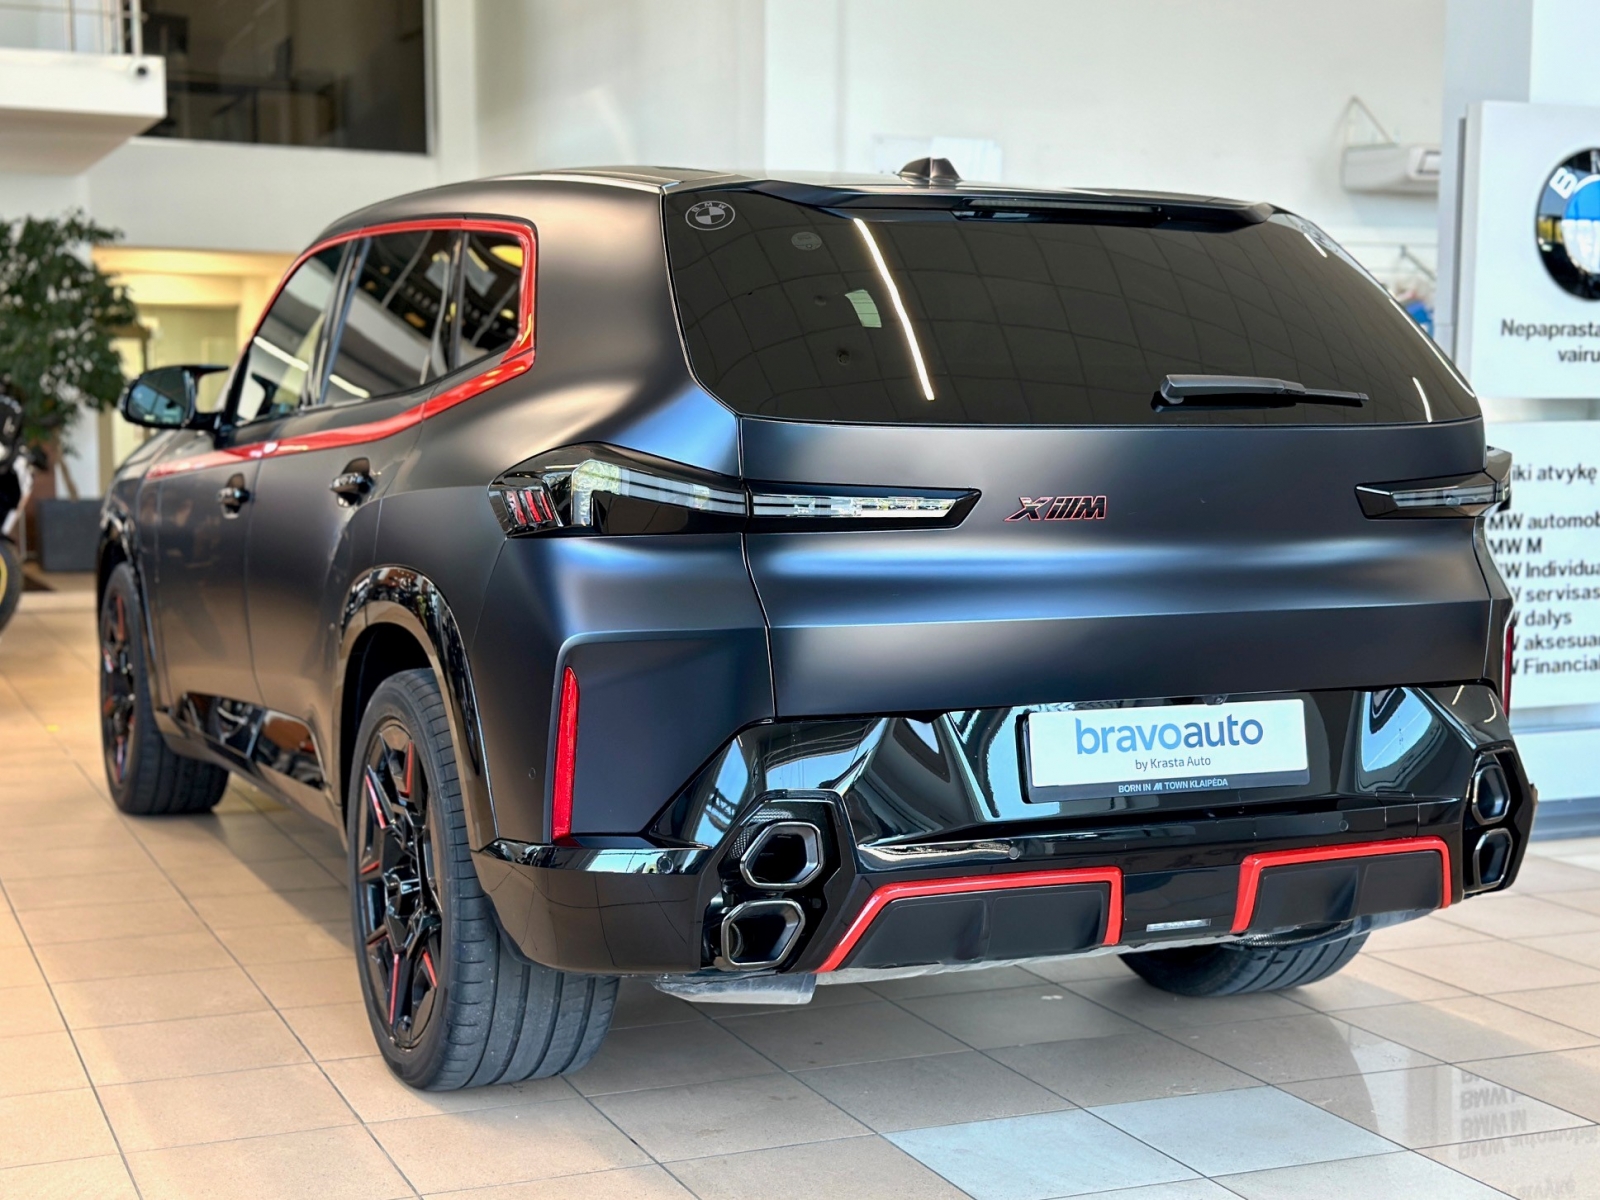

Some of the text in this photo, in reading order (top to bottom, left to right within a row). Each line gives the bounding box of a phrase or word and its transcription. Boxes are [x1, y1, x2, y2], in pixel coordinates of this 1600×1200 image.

[1501, 318, 1600, 341] Nepaprasta
[1558, 345, 1600, 363] vairu
[1512, 462, 1597, 486] iki atvykę
[1487, 513, 1523, 531] MW
[1489, 537, 1542, 555] MW M
[1526, 583, 1600, 603] servisas
[1524, 609, 1572, 630] dalys
[1075, 714, 1264, 755] bravoauto
[1135, 756, 1212, 772] by Krasta Auto
[1118, 784, 1142, 793] BORN
[1143, 783, 1152, 792] IN
[1164, 780, 1189, 790] TOWN
[1190, 777, 1229, 788] KLAIPĖDA
